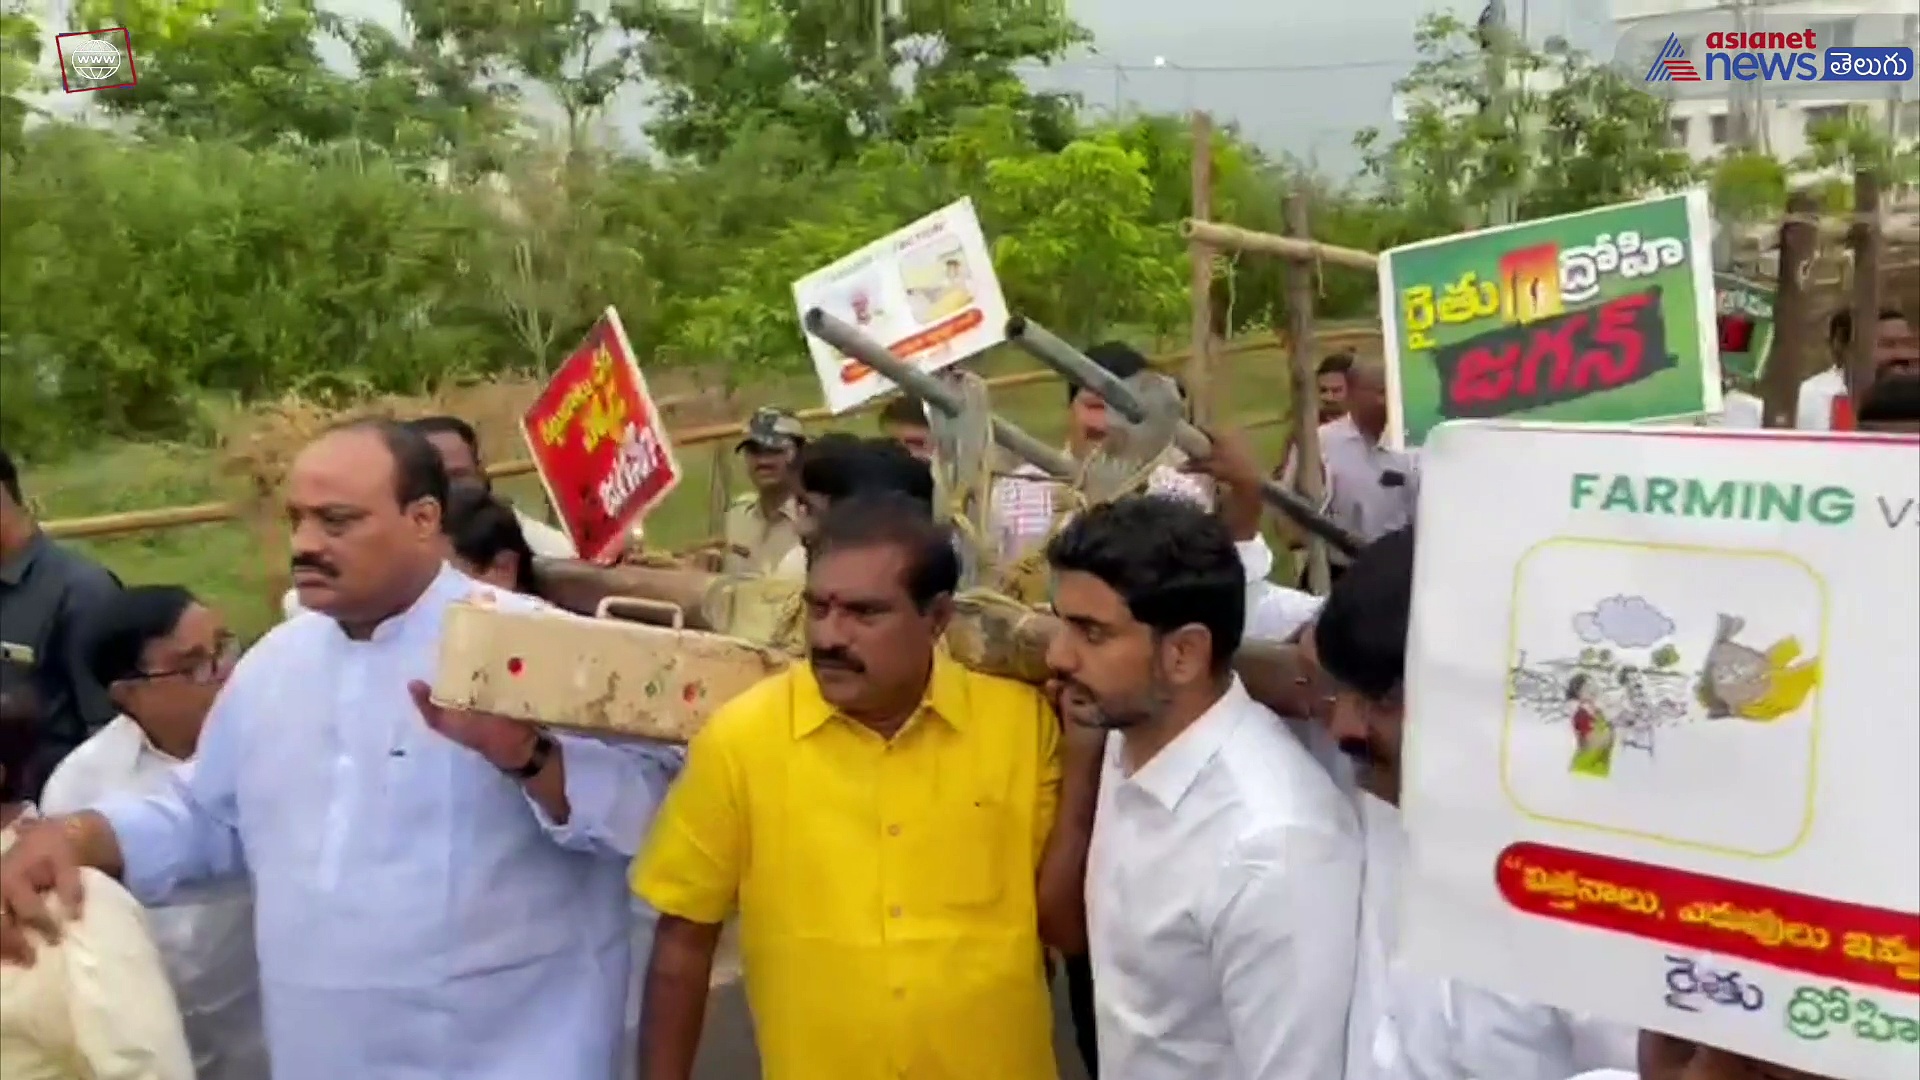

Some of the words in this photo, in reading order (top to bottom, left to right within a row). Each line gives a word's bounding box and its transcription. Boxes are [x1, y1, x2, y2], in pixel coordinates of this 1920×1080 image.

[1403, 269, 1499, 350] రైతు
[1559, 230, 1685, 302] ద్రోహి
[1450, 292, 1655, 405] జగన్
[1570, 473, 1856, 525] FARMING
